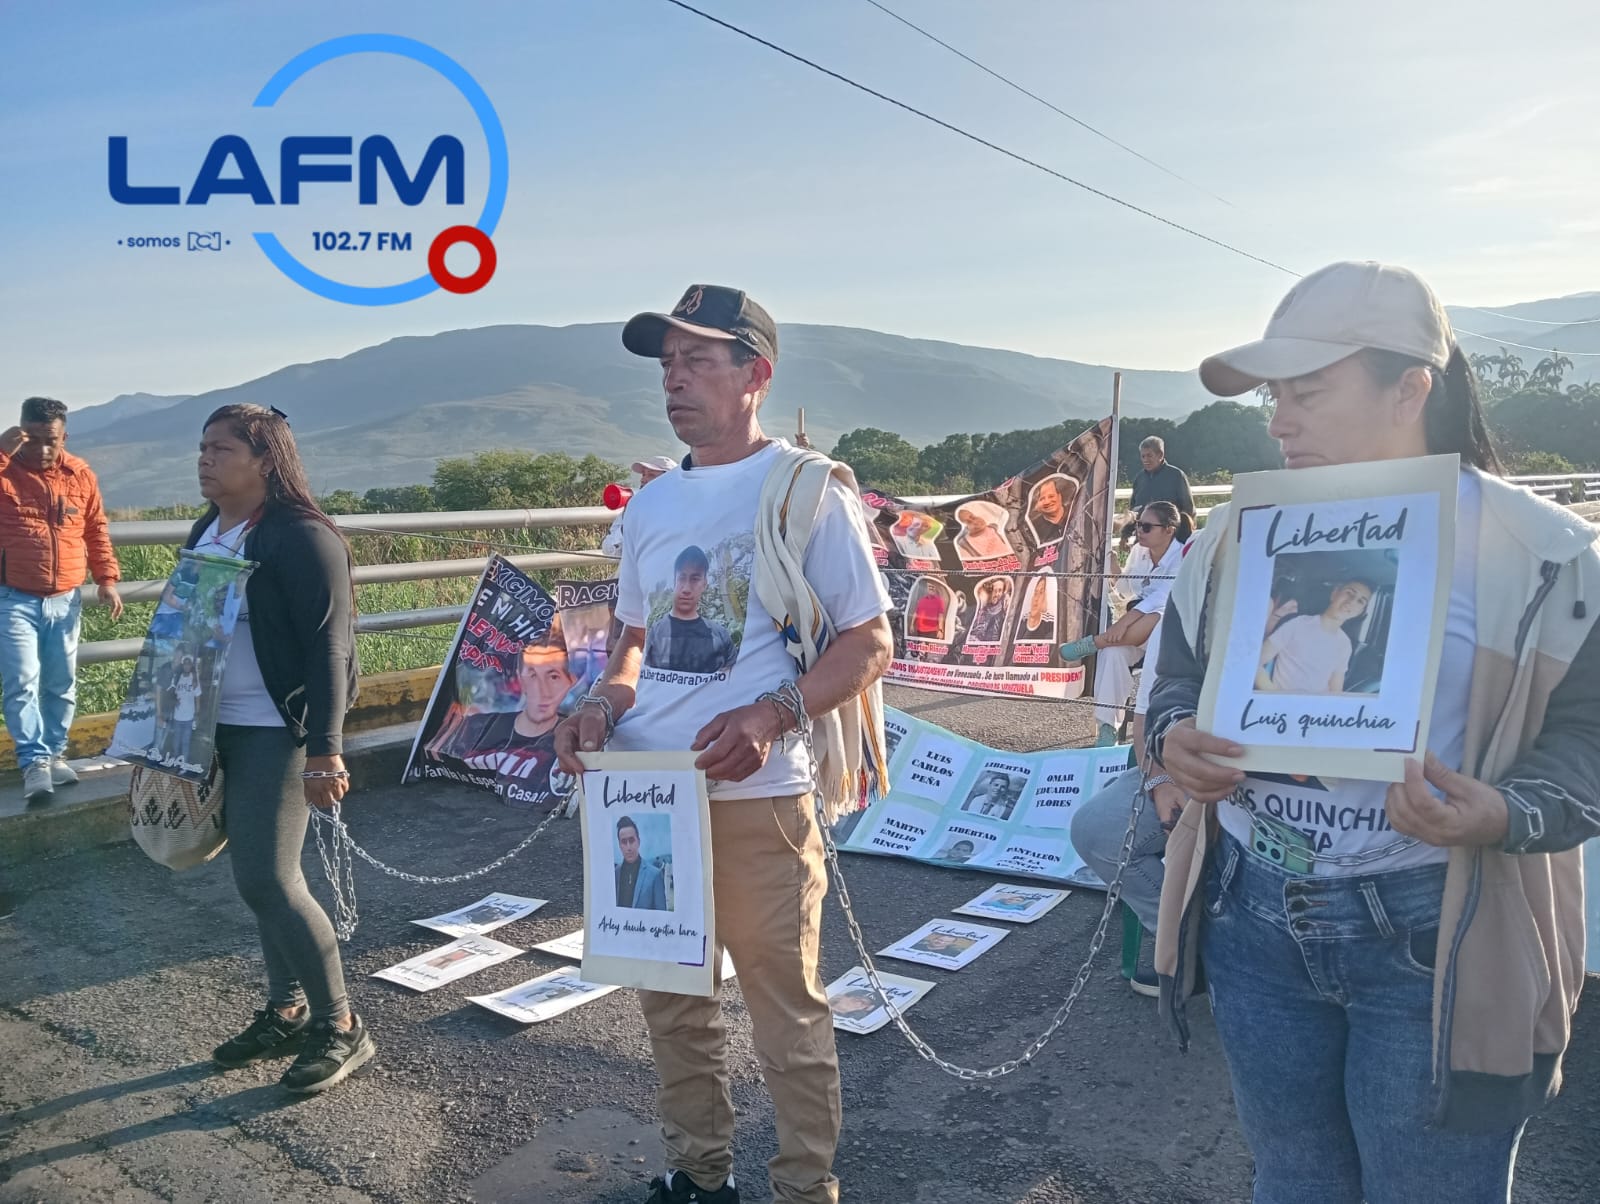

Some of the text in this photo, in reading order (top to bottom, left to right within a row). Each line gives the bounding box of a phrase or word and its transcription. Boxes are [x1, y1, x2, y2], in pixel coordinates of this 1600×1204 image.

[1265, 507, 1409, 558] Libertad
[1240, 698, 1397, 738] Luis quinchia
[926, 750, 953, 764] LUIS
[911, 758, 955, 777] CARLOS
[984, 761, 1031, 776] LIBERTAD
[911, 773, 942, 787] PEÑA
[1046, 774, 1075, 783] OMAR
[602, 775, 677, 810] Libertad
[1035, 786, 1080, 795] EDUARDO
[1035, 799, 1072, 808] FLORES
[884, 817, 927, 836] MARTIN
[948, 825, 998, 842] LIBERTAD
[879, 828, 917, 843] EMILIO
